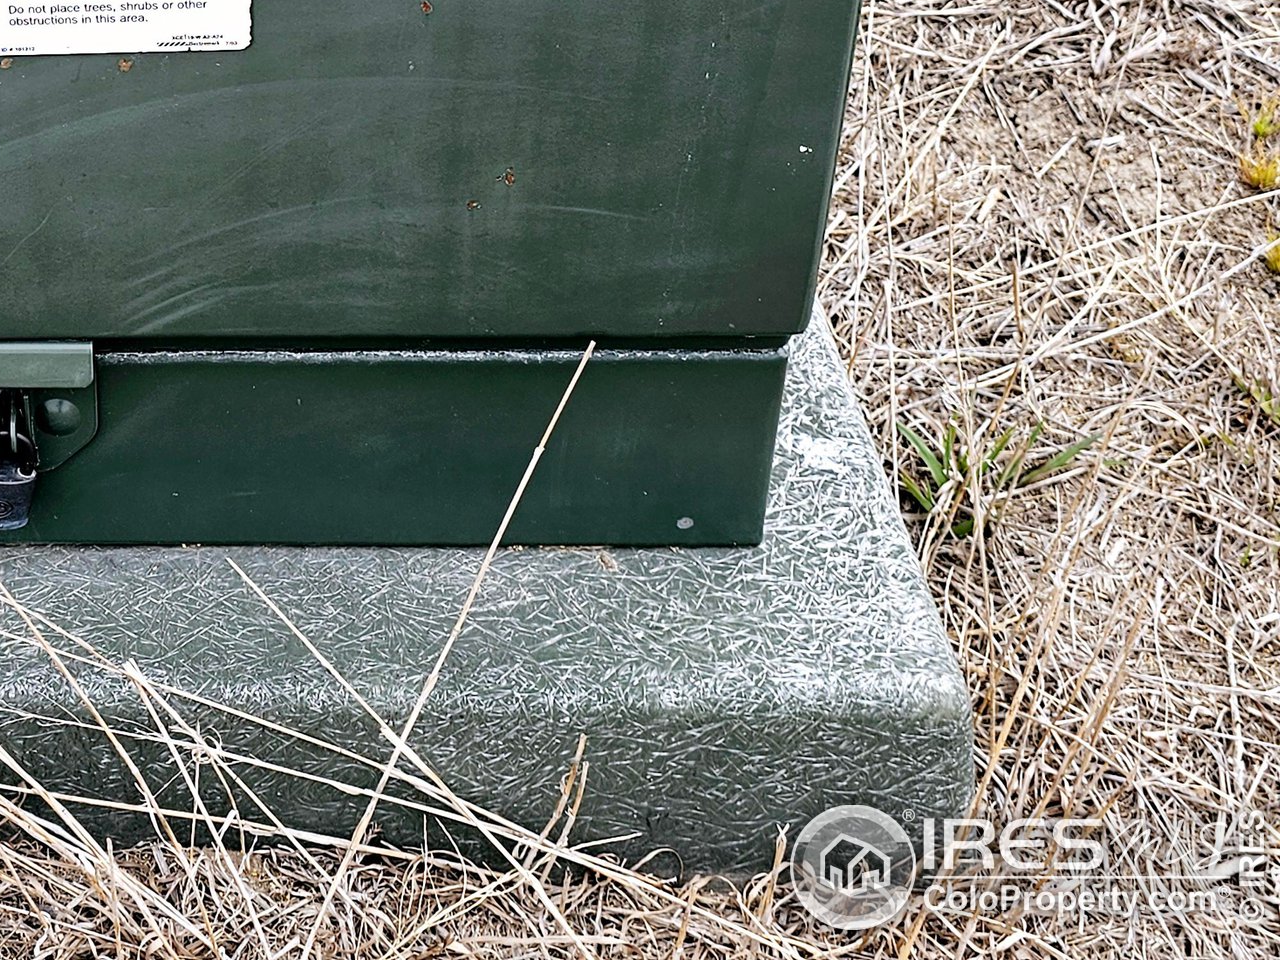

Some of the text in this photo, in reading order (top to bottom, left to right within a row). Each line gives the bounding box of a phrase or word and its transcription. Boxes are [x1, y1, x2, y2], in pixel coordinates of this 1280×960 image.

[9, 0, 207, 14] Do not place trees, shrubs or other
[9, 14, 148, 26] obstructions in this area.
